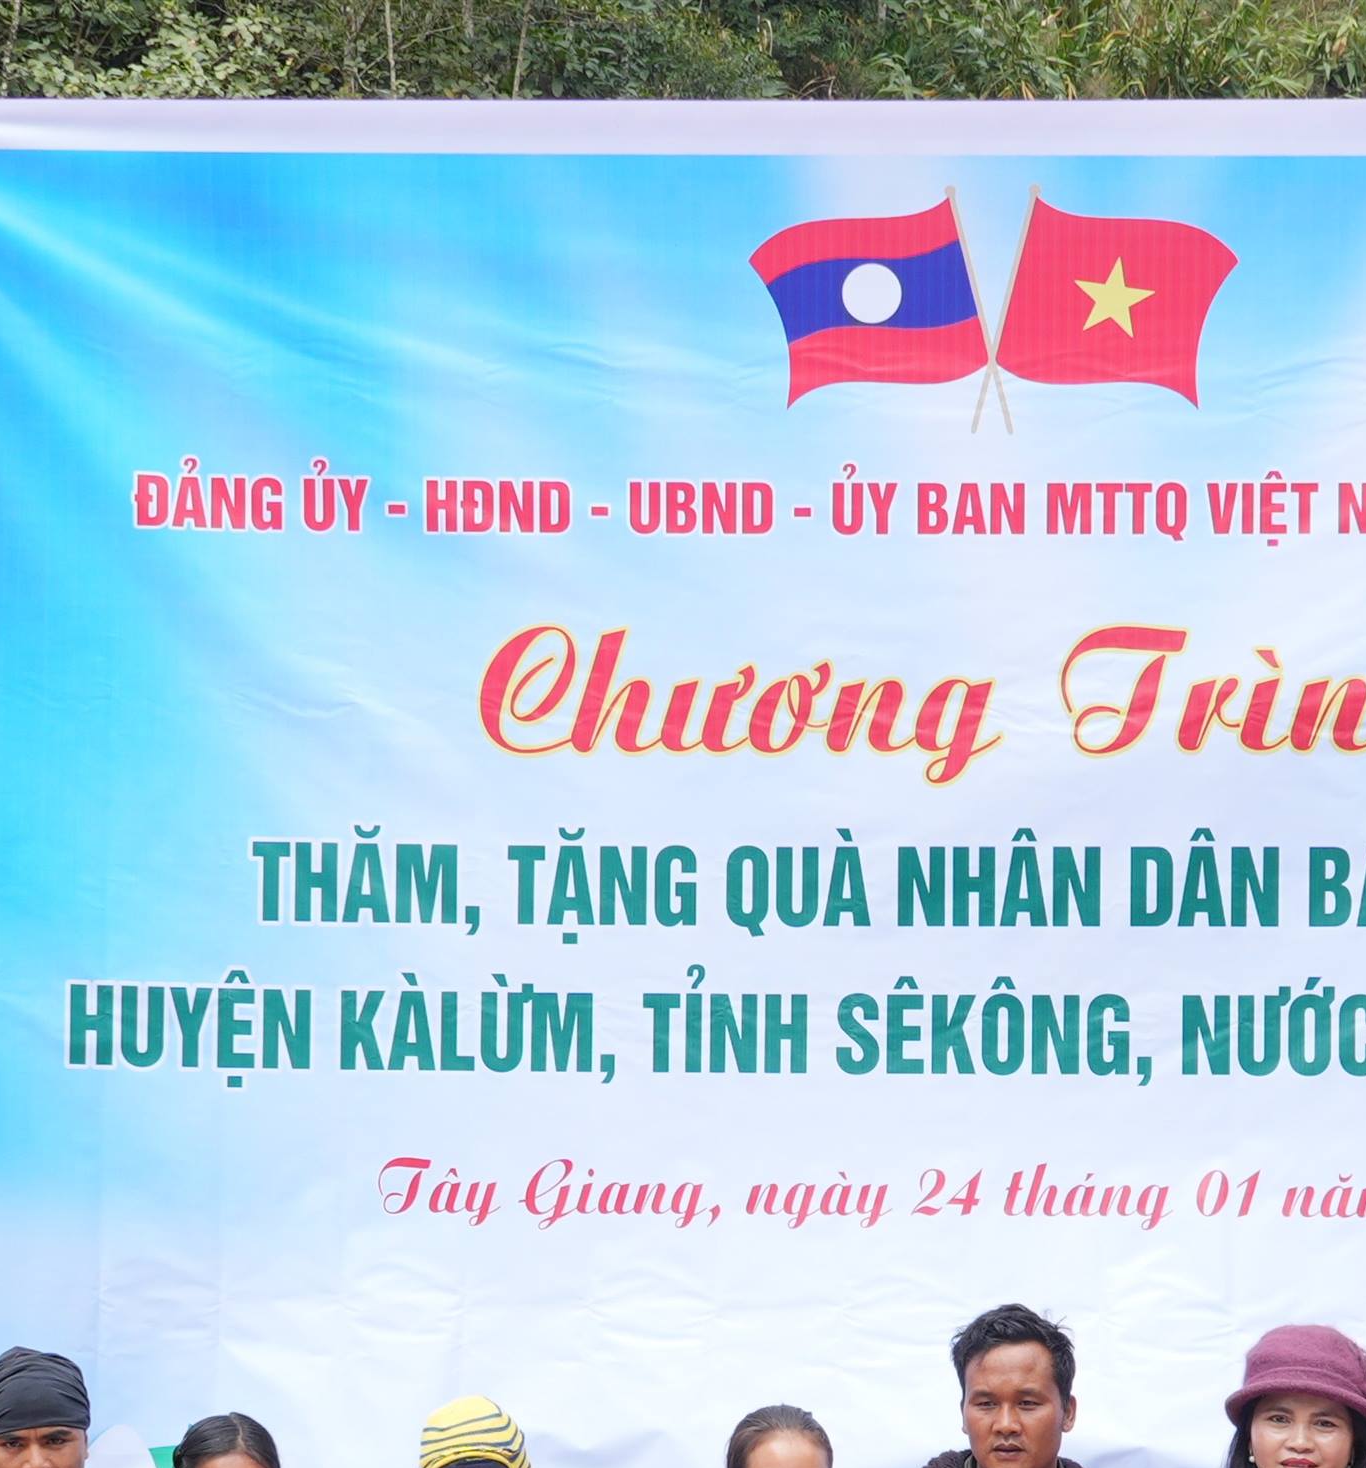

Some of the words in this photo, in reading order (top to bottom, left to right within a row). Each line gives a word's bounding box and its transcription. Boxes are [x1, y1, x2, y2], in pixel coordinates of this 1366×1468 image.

[133, 457, 283, 531] ĐẢNG
[301, 459, 368, 532] ỦY
[426, 478, 571, 533] HĐND
[629, 481, 775, 534] UBND
[831, 464, 897, 535] ỦY
[916, 482, 1024, 534] BAN
[1047, 482, 1189, 540] MTTQ
[1207, 471, 1319, 546] VIỆT
[479, 624, 1002, 786] Chương
[250, 825, 482, 935] THĂM,
[508, 828, 698, 944] TẶNG
[726, 829, 872, 938] QUÀ
[898, 832, 1100, 927] NHÂN
[1130, 832, 1280, 927] DÂN
[68, 969, 313, 1088] HUYỆN
[340, 972, 615, 1083] KÀLỪM,
[642, 964, 806, 1074] TỈNH
[836, 976, 1153, 1085] SÊKÔNG,
[377, 1157, 500, 1224] Tây
[520, 1157, 721, 1227] Giang,
[746, 1171, 892, 1227] ngày
[910, 1167, 983, 1215] 24
[1002, 1163, 1174, 1230] tháng
[1196, 1169, 1261, 1217] 01
